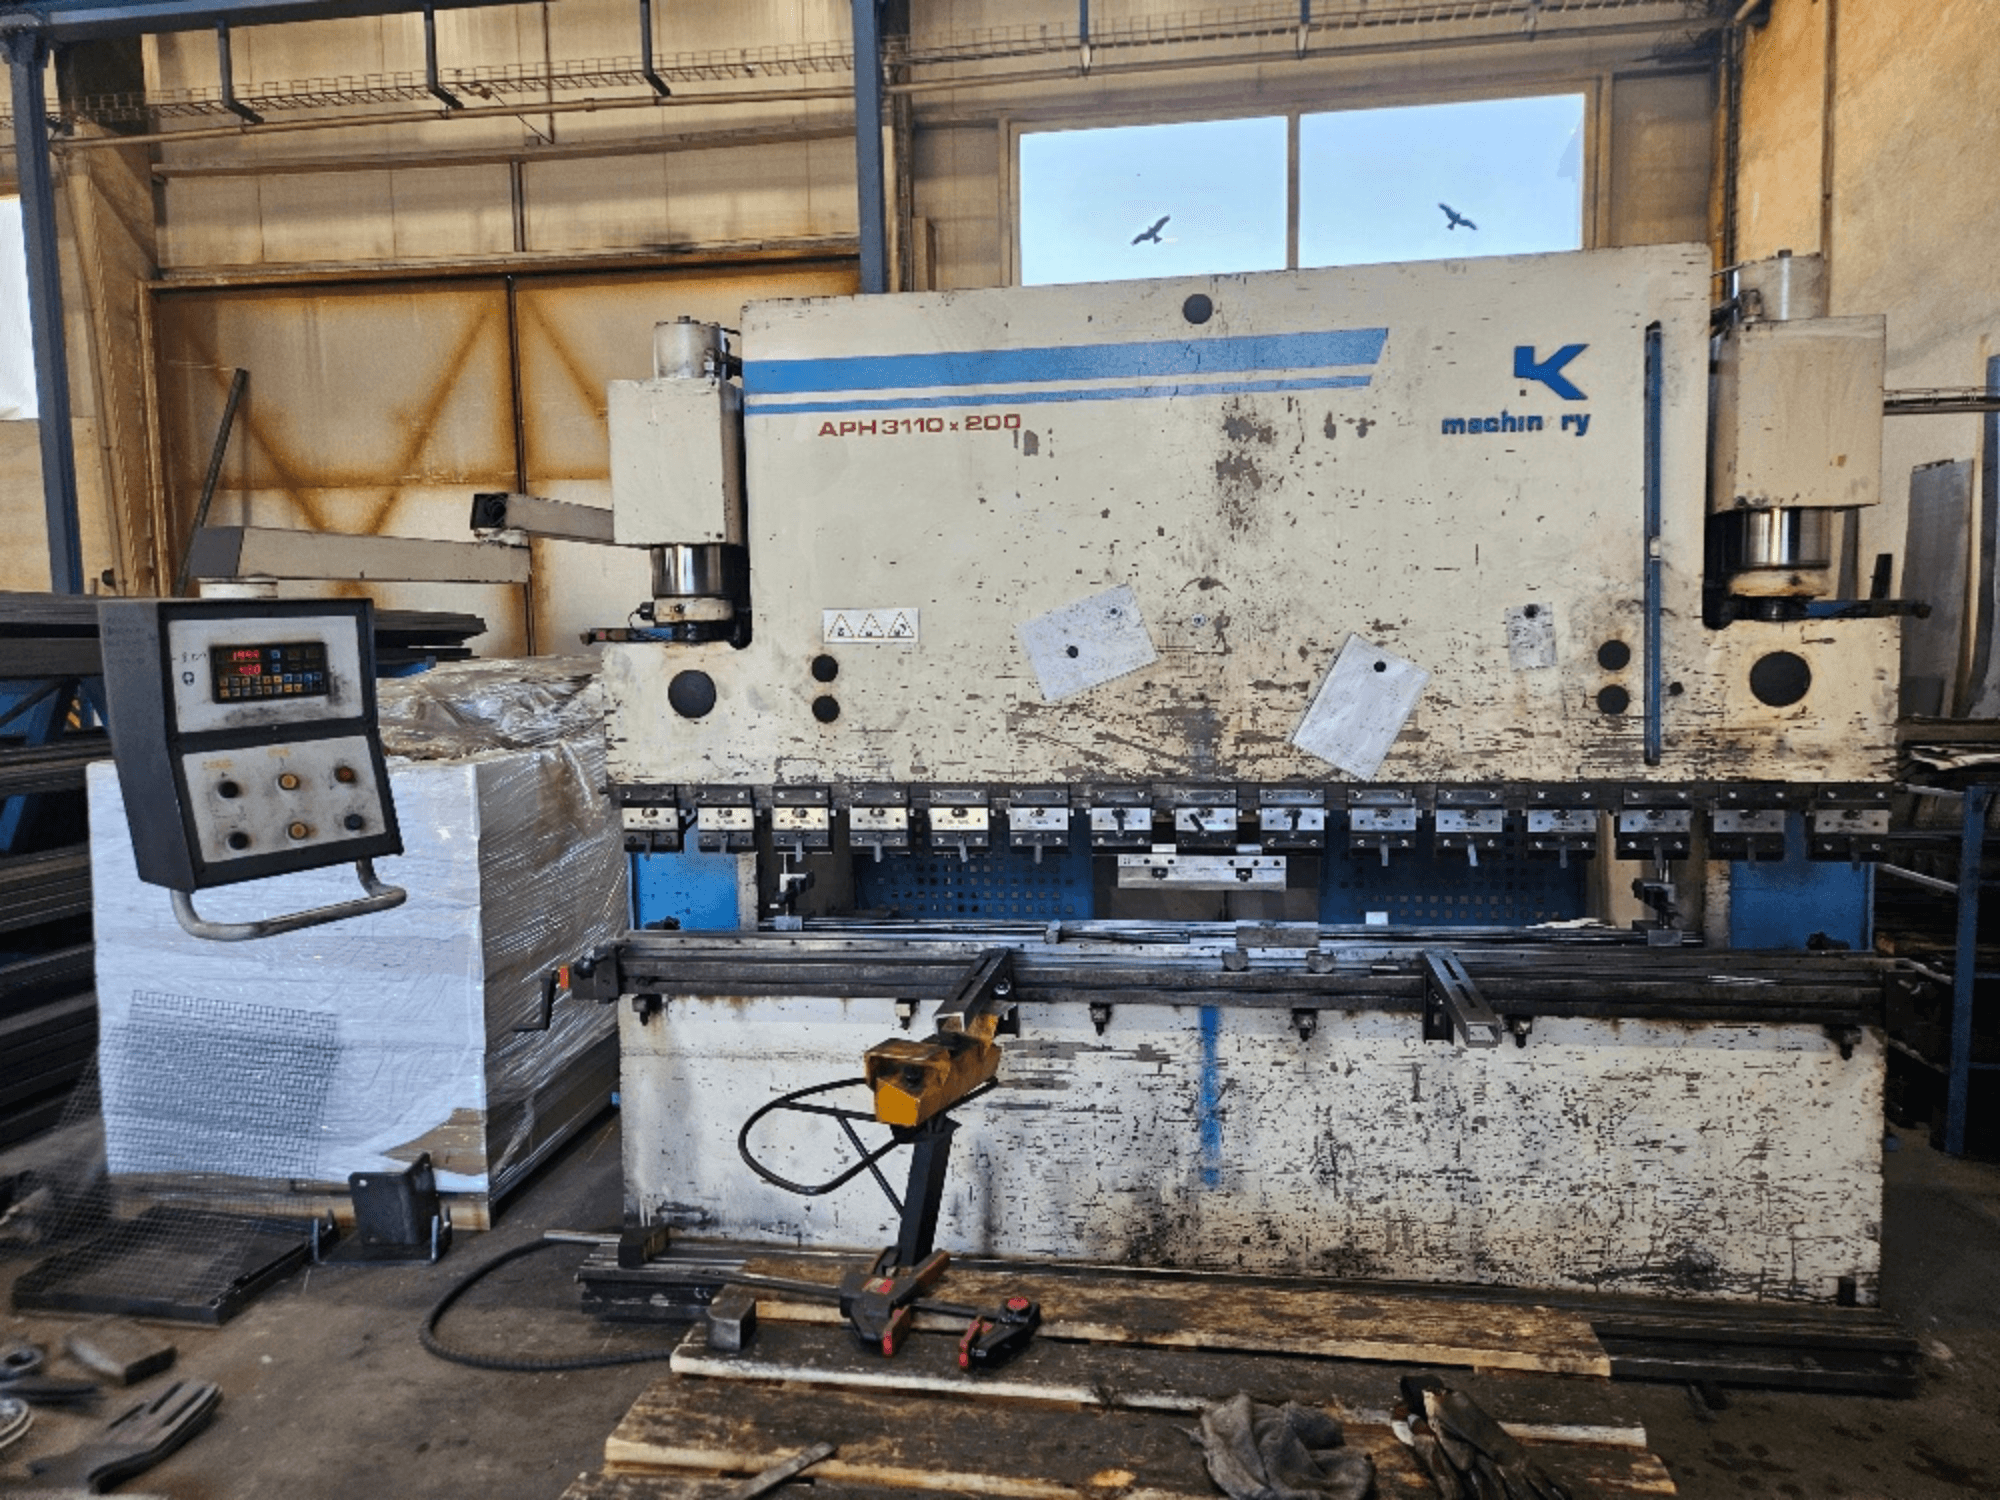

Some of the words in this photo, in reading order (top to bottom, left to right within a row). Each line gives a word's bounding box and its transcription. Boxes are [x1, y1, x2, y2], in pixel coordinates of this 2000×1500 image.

[1514, 343, 1590, 400] K
[818, 419, 877, 437] APH
[881, 417, 944, 435] 3110
[965, 413, 1021, 431] 200
[1441, 409, 1591, 437] machinry
